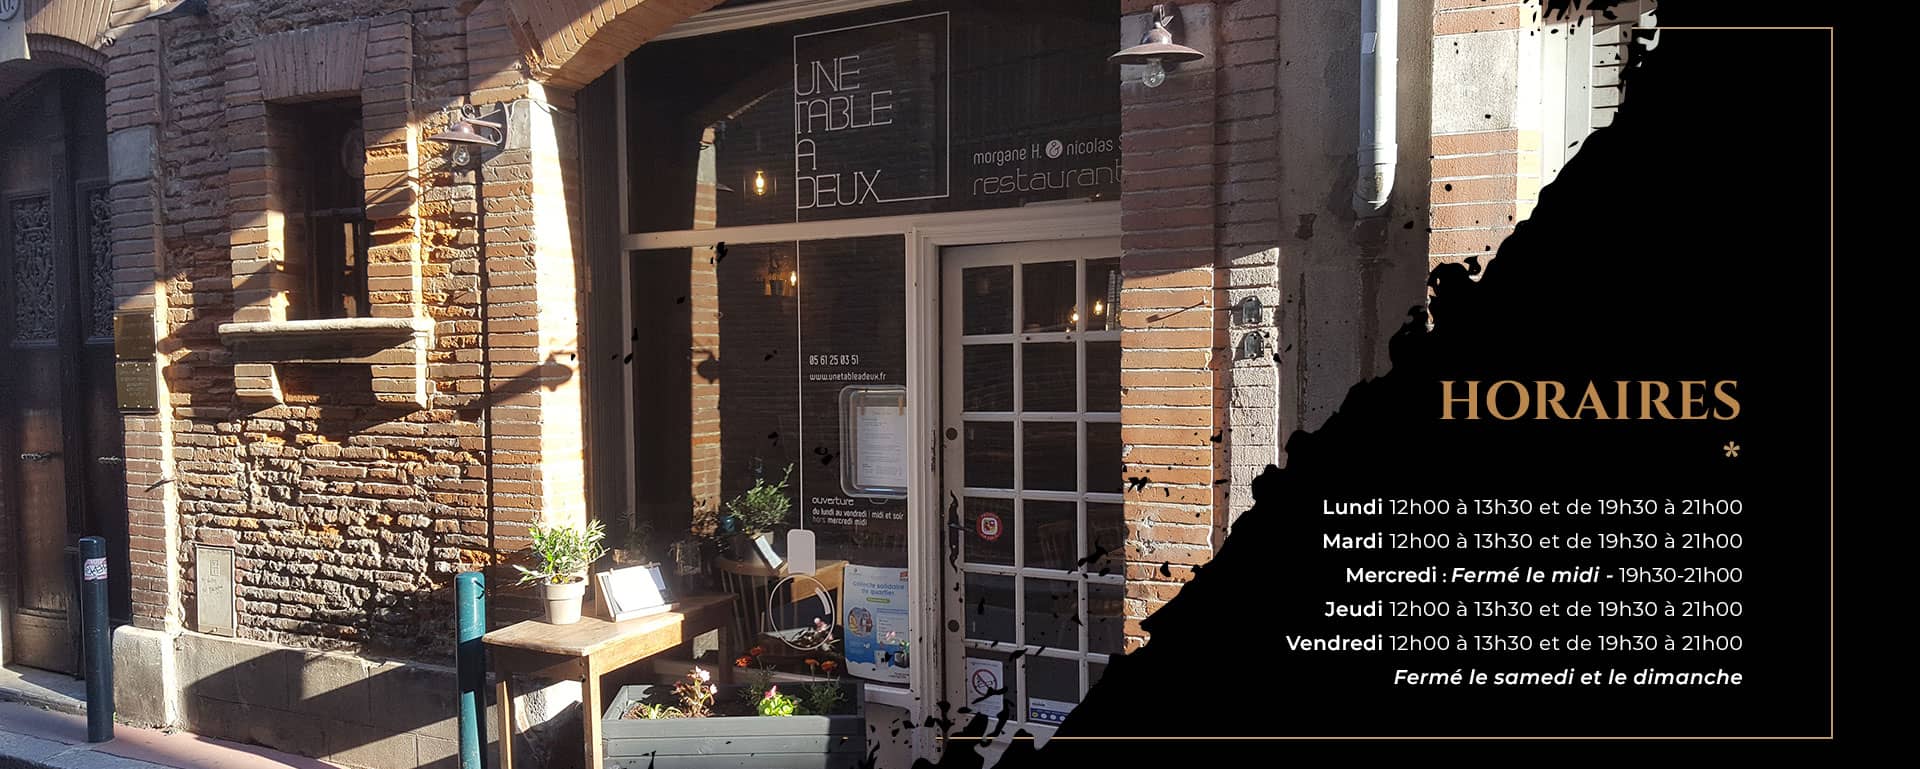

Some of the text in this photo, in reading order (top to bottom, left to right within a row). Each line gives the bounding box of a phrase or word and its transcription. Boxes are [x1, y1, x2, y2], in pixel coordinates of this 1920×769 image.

[795, 55, 860, 96] UNE
[796, 90, 893, 134] TABLE
[796, 138, 817, 171] A
[973, 148, 1027, 166] morgane
[1031, 144, 1042, 159] H.
[1066, 138, 1113, 156] nicolas
[796, 169, 882, 209] DEUX
[973, 158, 1123, 196] restaurant
[820, 354, 828, 366] 61
[829, 354, 839, 366] 25
[851, 354, 859, 366] 51
[809, 371, 887, 381] www.unetableadeux.fr
[812, 497, 854, 505] ouverture
[812, 507, 820, 515] du
[820, 508, 834, 516] lundi
[844, 509, 867, 518] vendredi
[871, 511, 884, 519] midi
[885, 512, 891, 520] et
